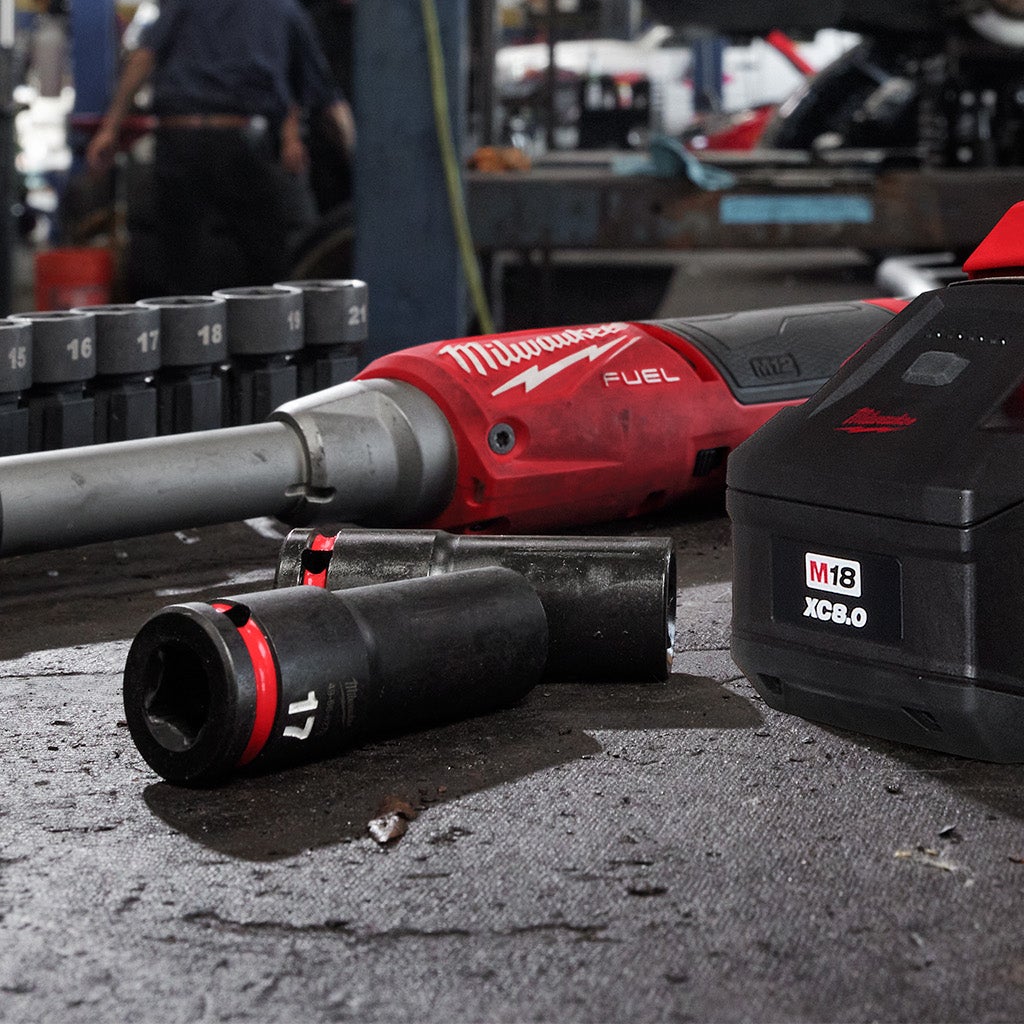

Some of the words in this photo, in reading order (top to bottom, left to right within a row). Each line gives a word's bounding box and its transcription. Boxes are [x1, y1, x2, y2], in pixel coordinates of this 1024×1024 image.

[348, 304, 367, 326] 21
[137, 330, 159, 353] 17
[198, 324, 222, 346] 18
[8, 346, 26, 369] 15
[67, 337, 92, 360] 16
[604, 367, 680, 388] FUEL
[809, 560, 857, 590] M18
[803, 596, 868, 628] XC8.0
[283, 690, 319, 741] 17
